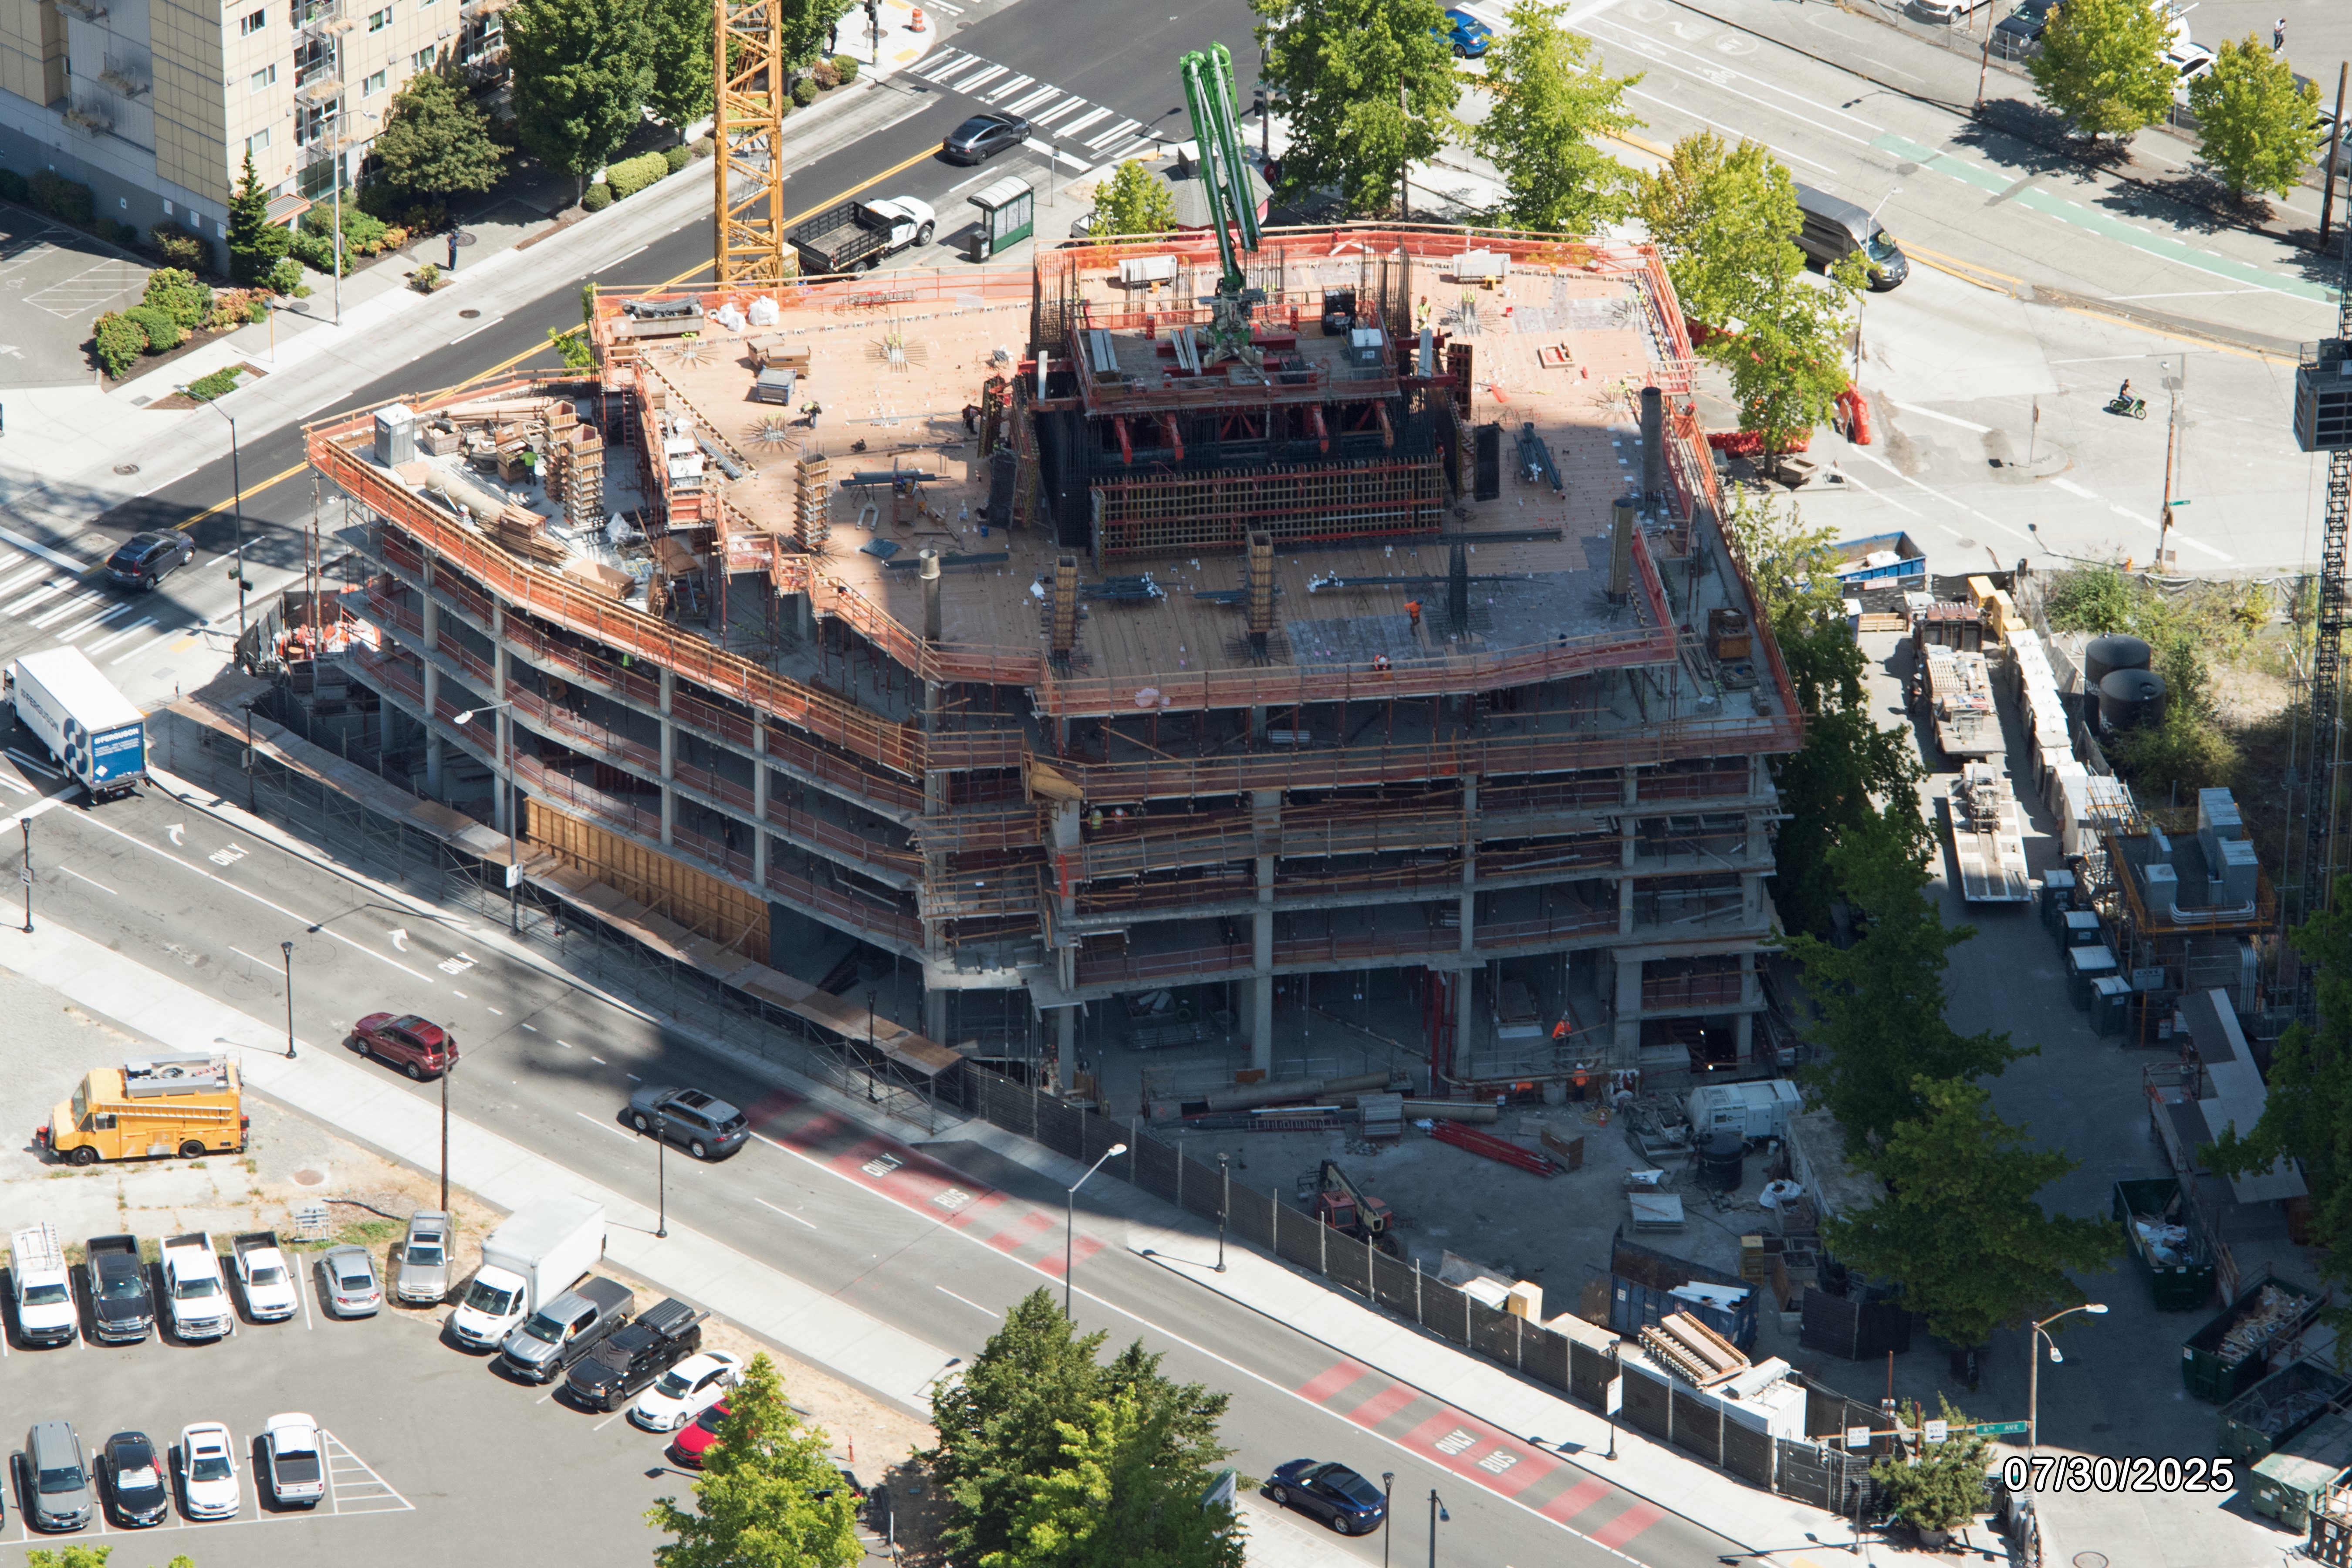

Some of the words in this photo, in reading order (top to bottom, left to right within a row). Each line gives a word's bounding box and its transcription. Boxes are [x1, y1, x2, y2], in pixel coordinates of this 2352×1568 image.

[26, 693, 59, 733] FERGUSON
[101, 727, 139, 743] FERGUSON
[208, 843, 249, 866] ONLY
[437, 951, 479, 975] ONLY
[862, 1152, 903, 1177] ONLY
[933, 1188, 970, 1209] BUS
[1435, 1429, 1477, 1456] ONLY
[1478, 1451, 1517, 1473] BUS
